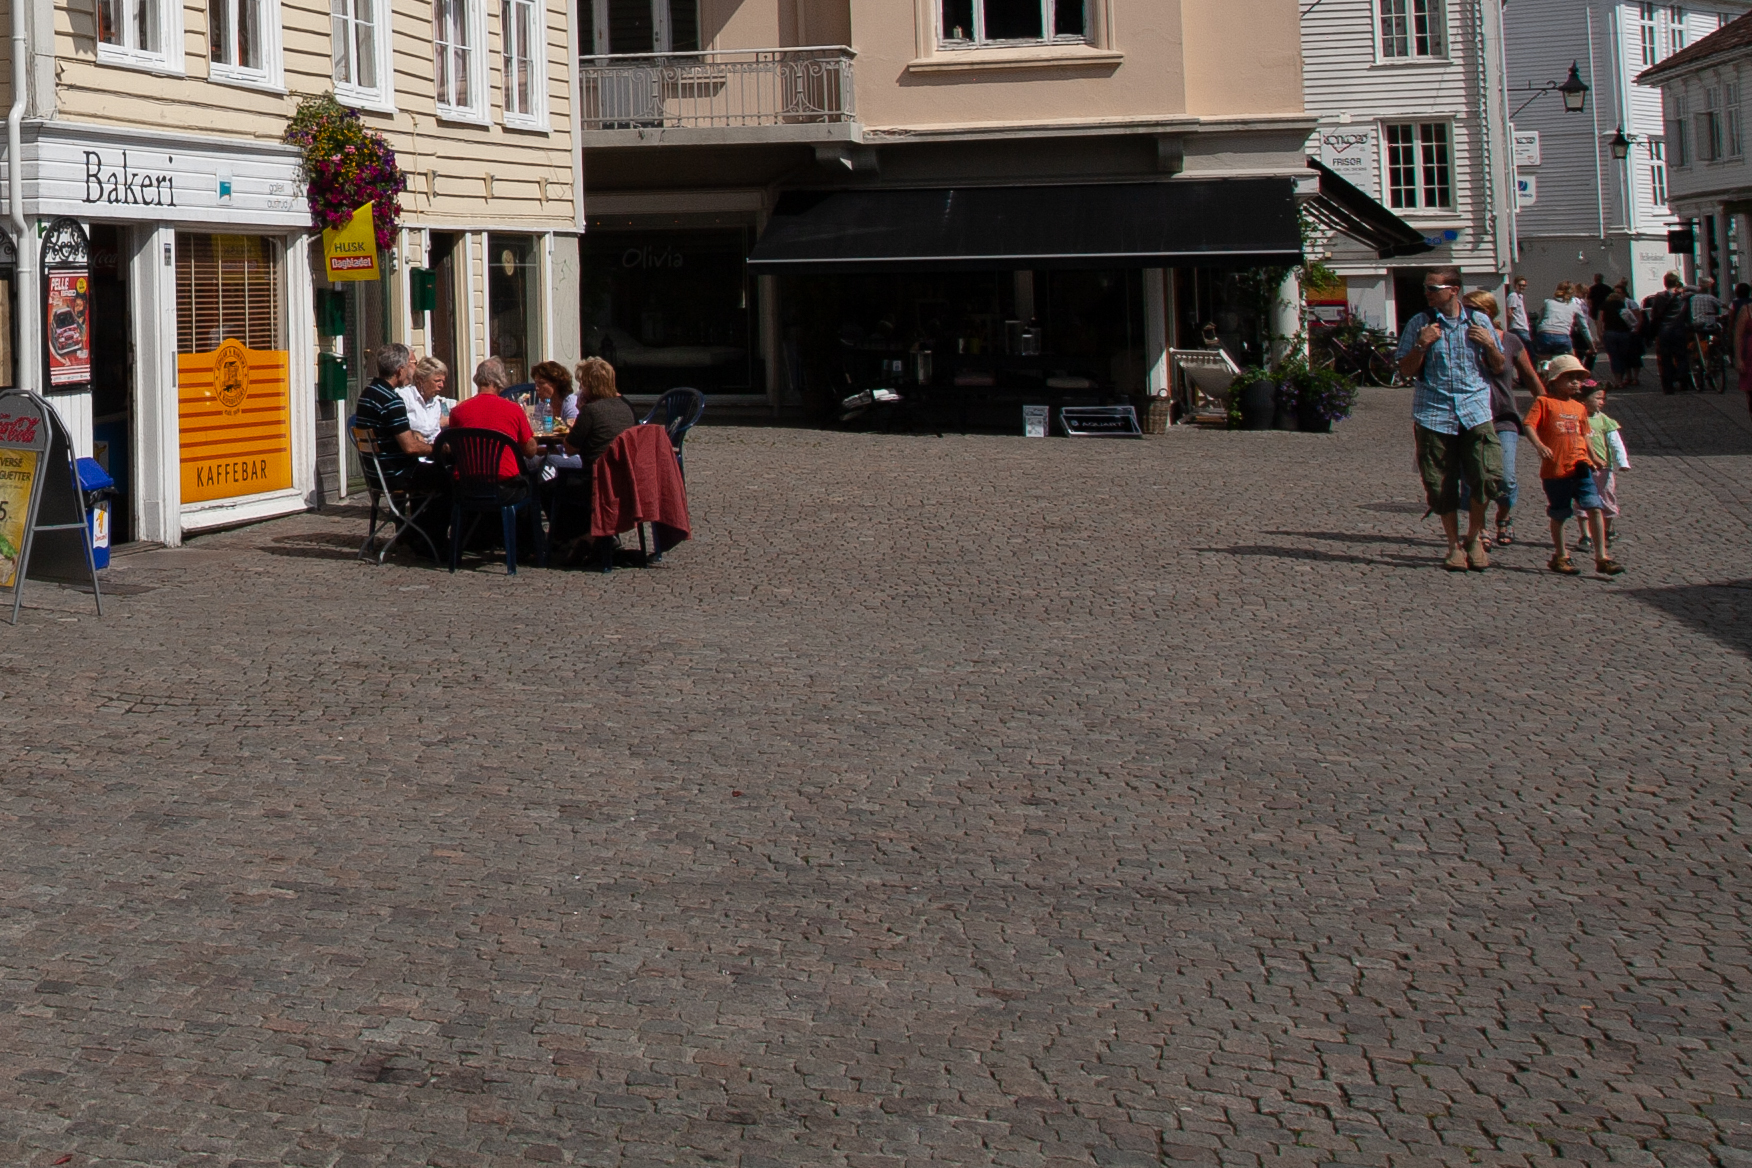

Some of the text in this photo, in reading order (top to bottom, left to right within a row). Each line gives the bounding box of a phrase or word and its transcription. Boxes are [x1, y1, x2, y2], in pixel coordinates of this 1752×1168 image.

[82, 149, 177, 207] Bakeri
[334, 241, 365, 252] HUSK
[331, 256, 372, 270] Dagbladet
[622, 245, 683, 269] Olivia
[50, 277, 70, 291] PELLE
[196, 459, 267, 488] KAFFEBAR
